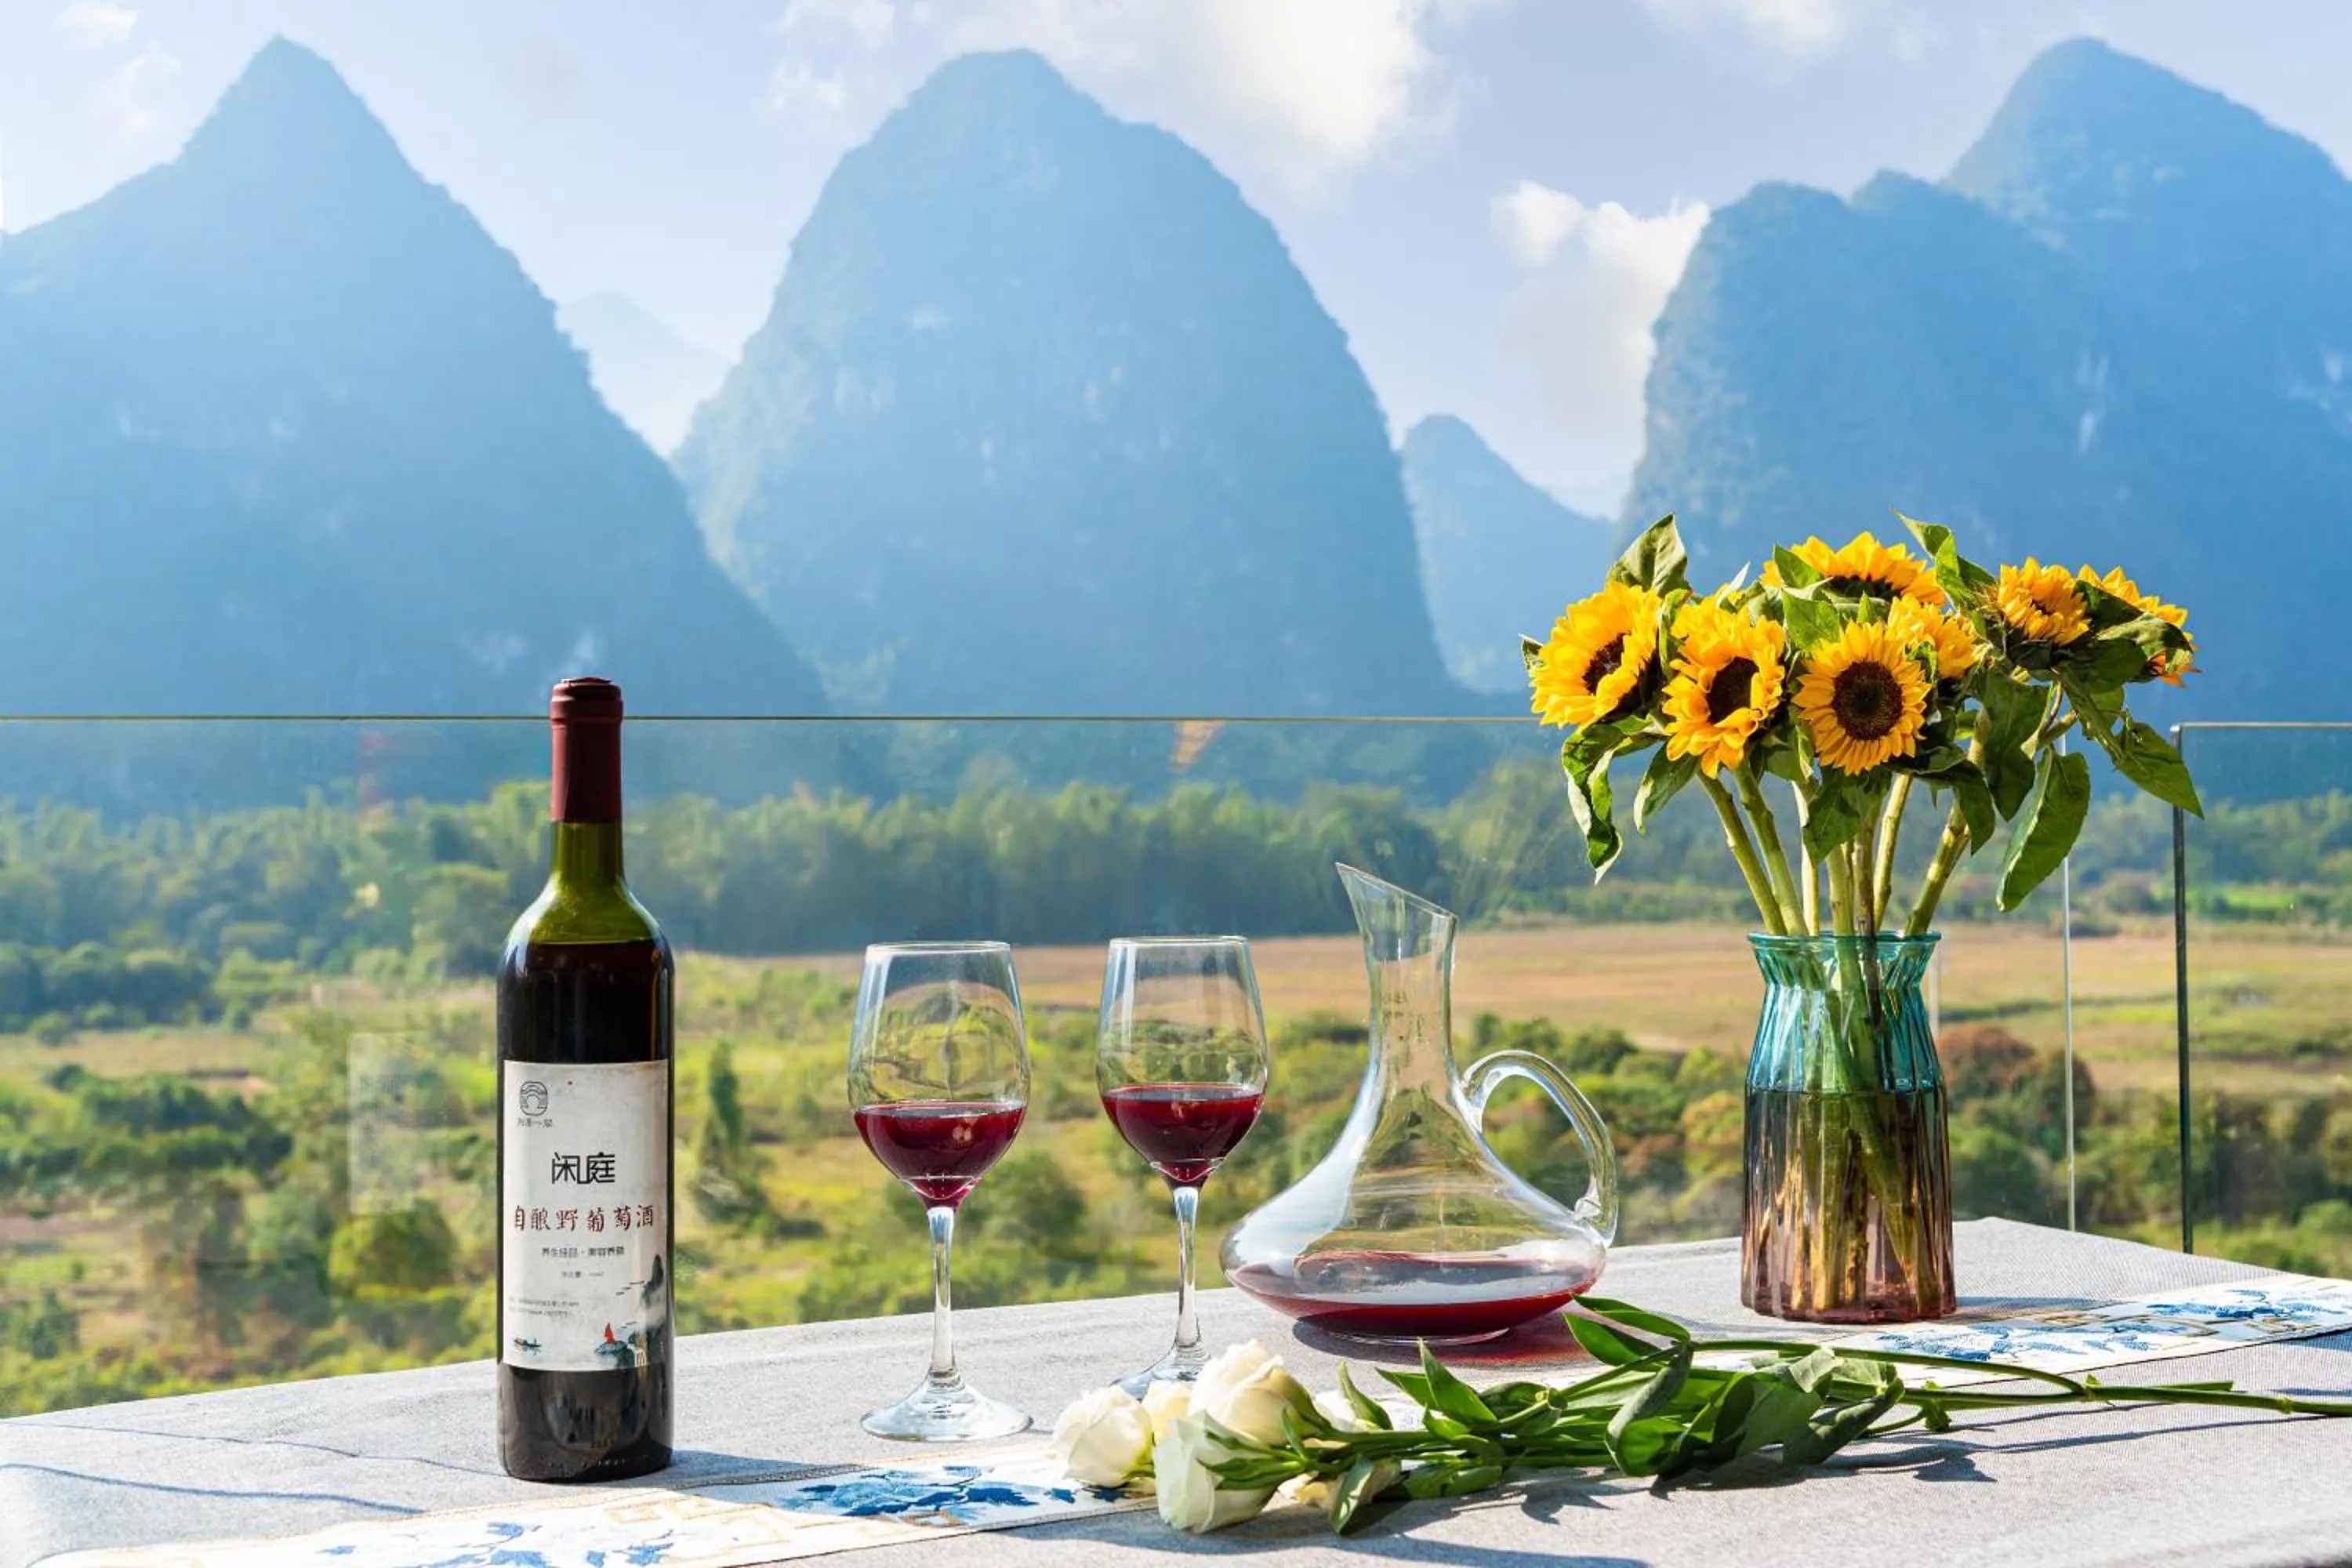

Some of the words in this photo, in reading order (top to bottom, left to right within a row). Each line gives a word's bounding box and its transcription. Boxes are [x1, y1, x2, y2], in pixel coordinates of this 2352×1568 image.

[551, 1152, 615, 1185] 闲庭
[514, 1204, 654, 1232] 自酿野葡萄酒
